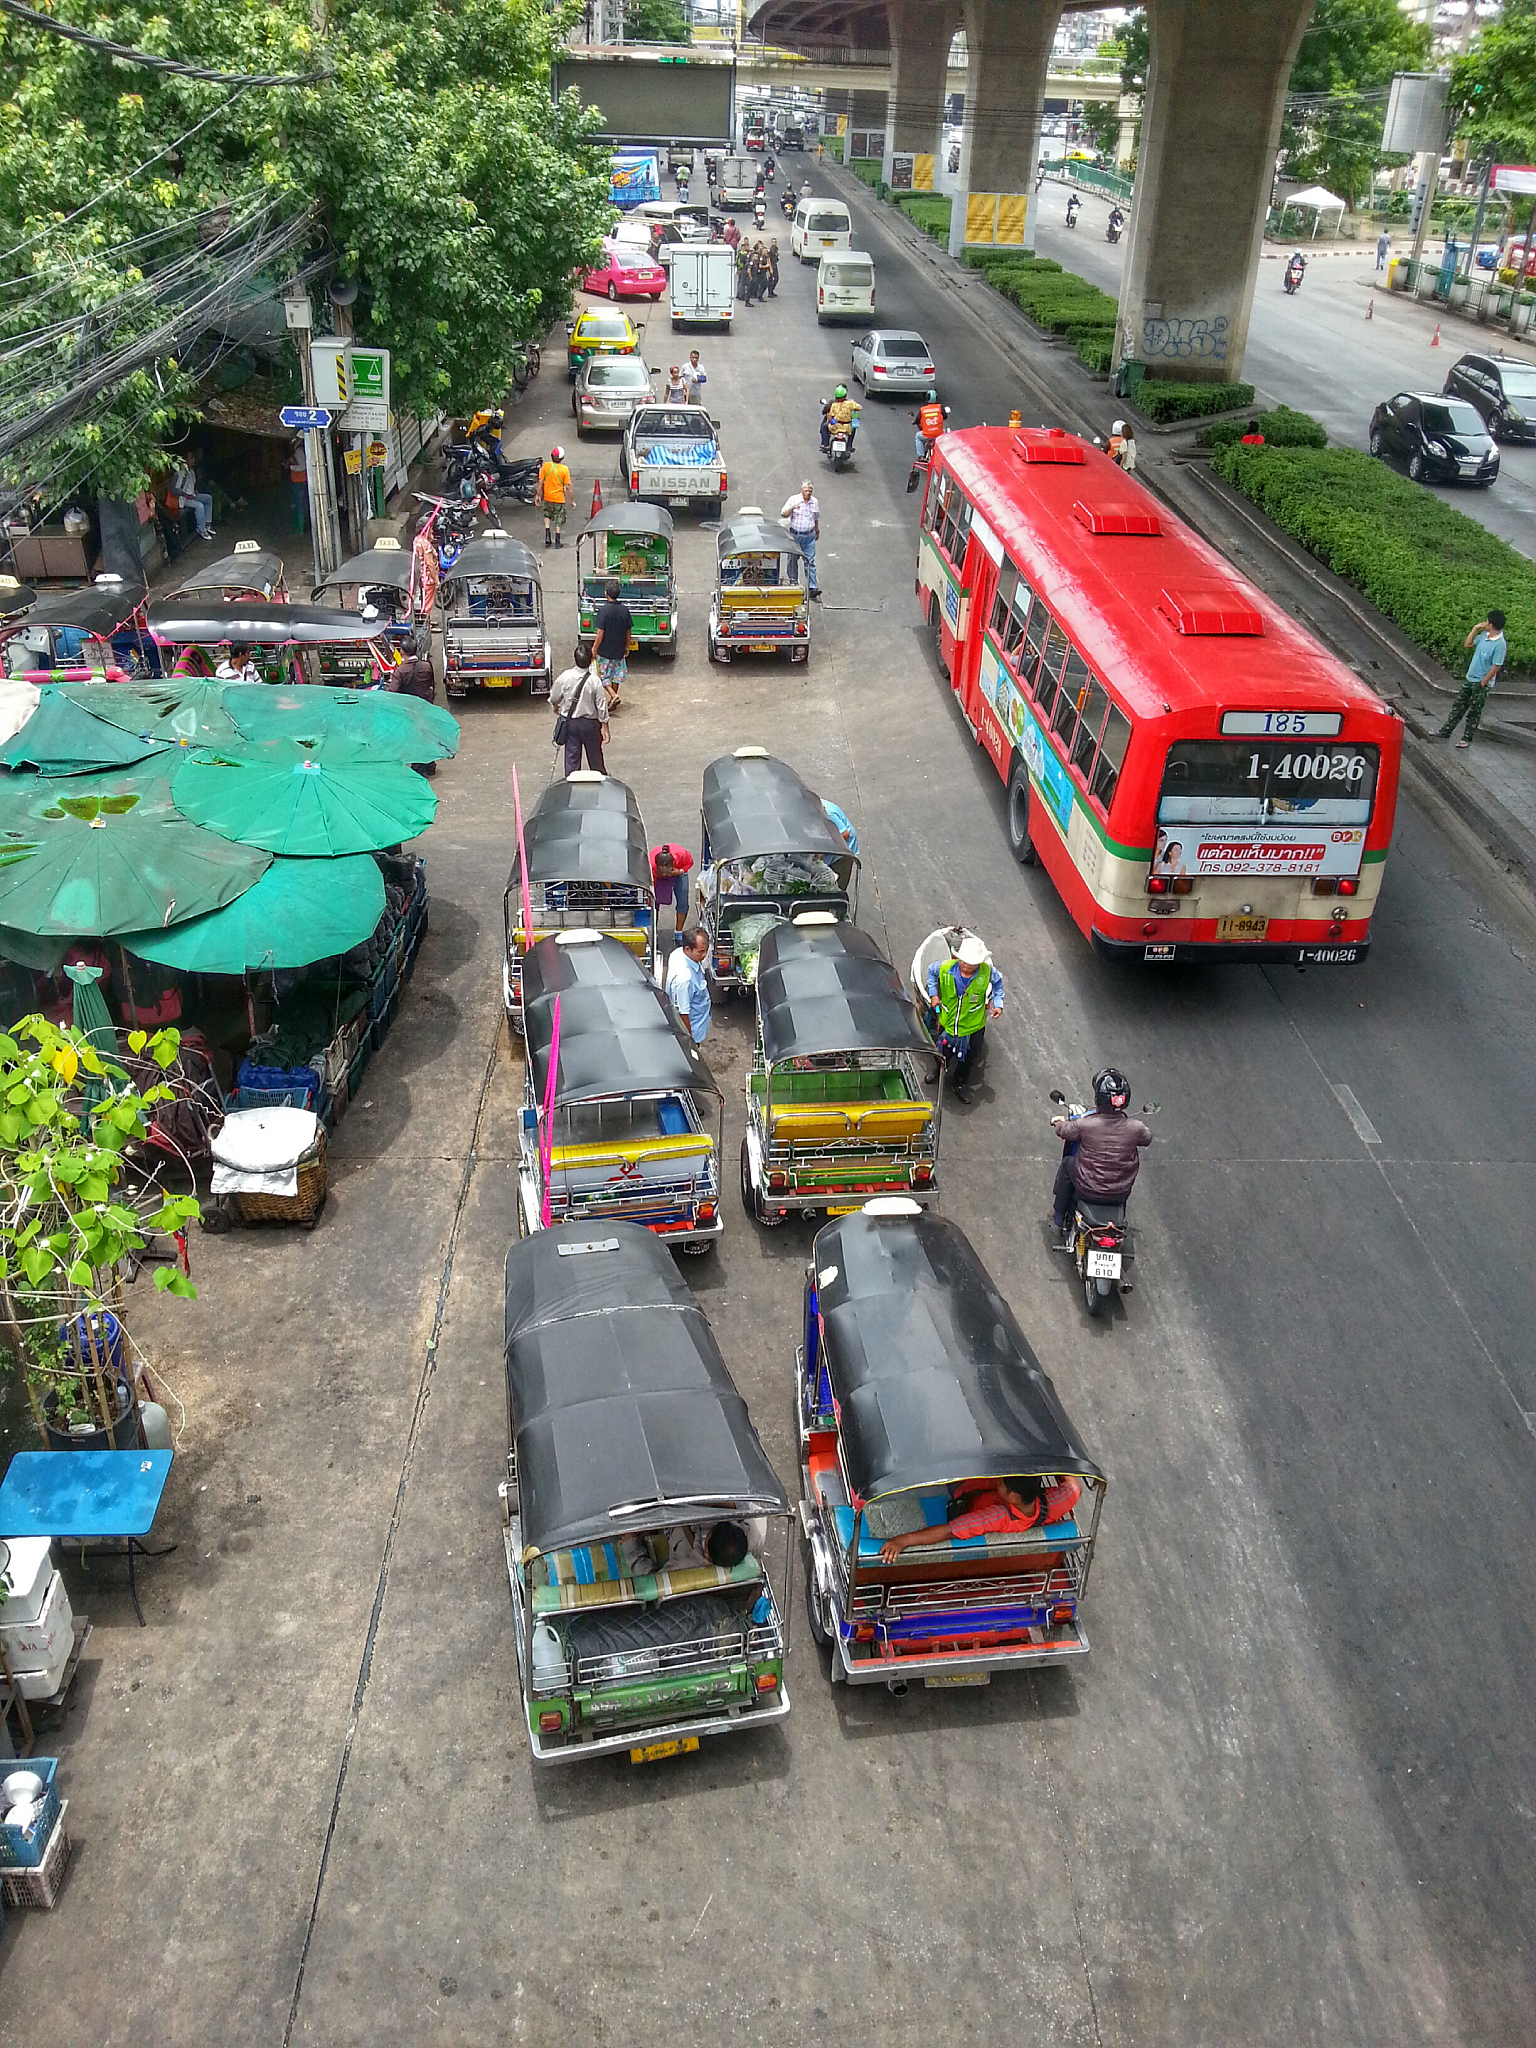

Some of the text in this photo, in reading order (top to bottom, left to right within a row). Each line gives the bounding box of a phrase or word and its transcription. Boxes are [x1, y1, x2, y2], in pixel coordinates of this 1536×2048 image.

[308, 410, 318, 421] 2
[650, 477, 710, 488] NISSAN
[237, 542, 254, 550] TAXI
[1262, 713, 1307, 733] 185
[1246, 753, 1366, 781] 1-40026
[1297, 949, 1357, 962] 1-40026
